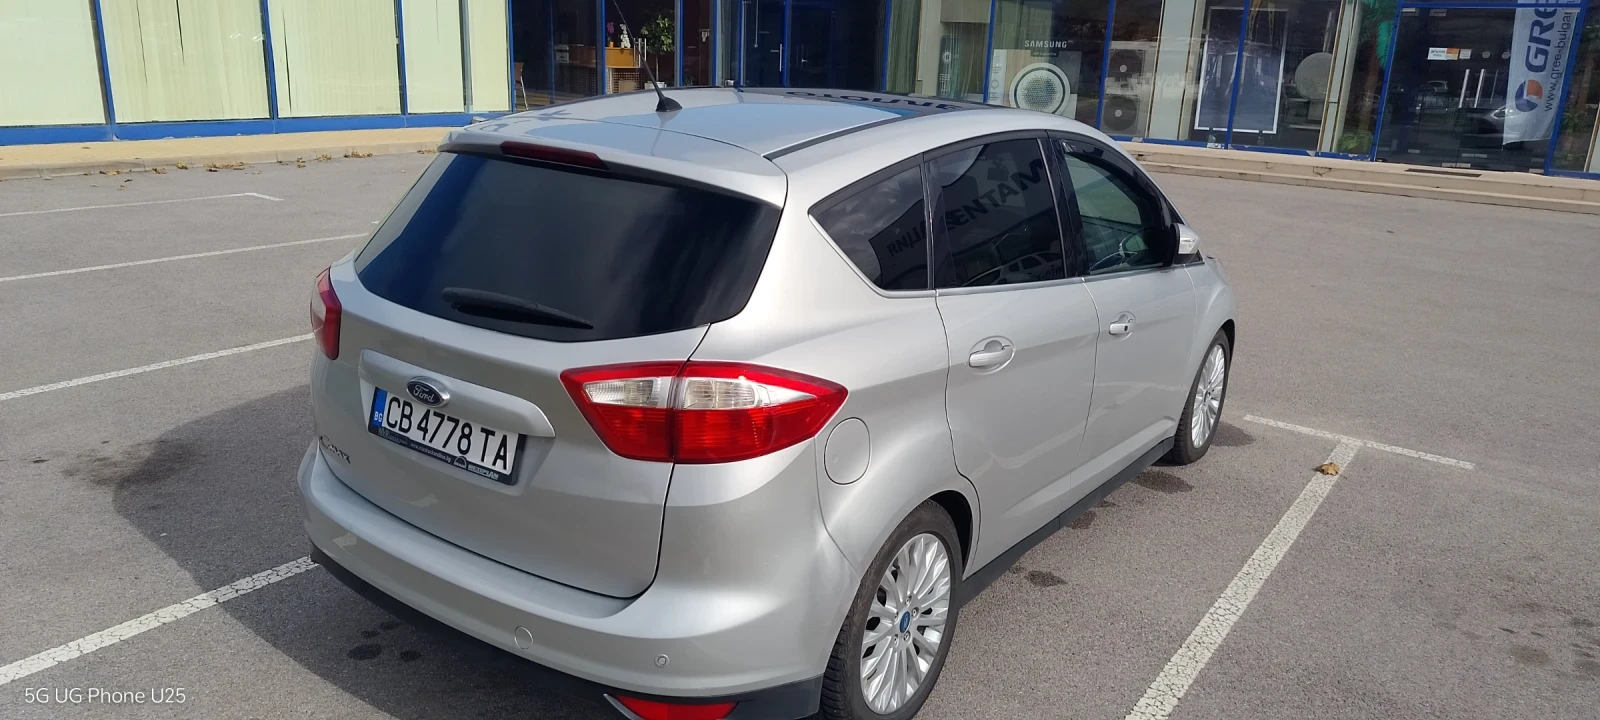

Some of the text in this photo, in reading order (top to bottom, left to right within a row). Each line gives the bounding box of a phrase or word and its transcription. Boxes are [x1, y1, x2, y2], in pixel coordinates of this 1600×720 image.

[1024, 40, 1067, 48] SAMSUNG
[413, 385, 435, 403] Ford
[374, 411, 383, 423] BG
[416, 408, 473, 455] 4778
[480, 428, 508, 471] TA
